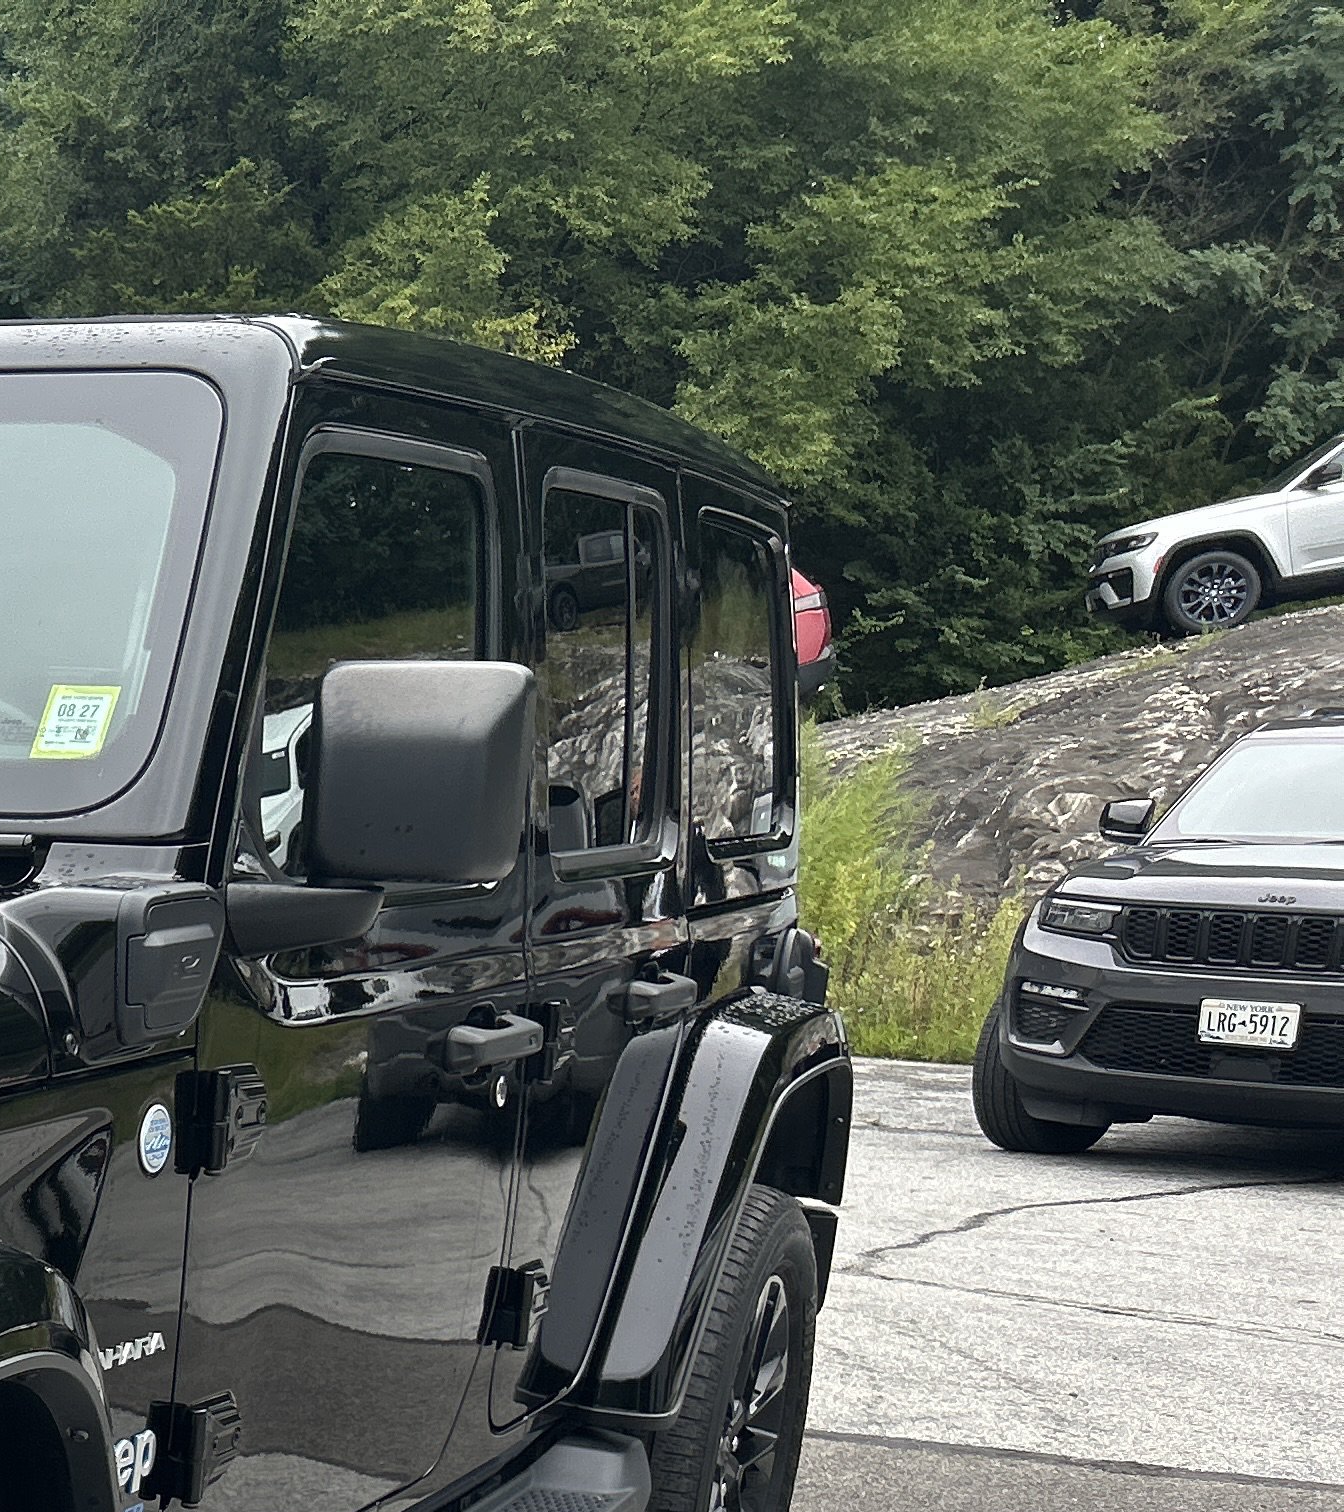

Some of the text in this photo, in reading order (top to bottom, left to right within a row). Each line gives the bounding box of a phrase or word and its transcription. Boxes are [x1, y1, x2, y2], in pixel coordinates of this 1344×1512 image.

[57, 703, 100, 718] 08 27
[1258, 893, 1297, 906] Jeep
[1226, 1003, 1274, 1014] NEW YORK
[1207, 1011, 1290, 1037] LRG 5912
[113, 1429, 157, 1493] ep
